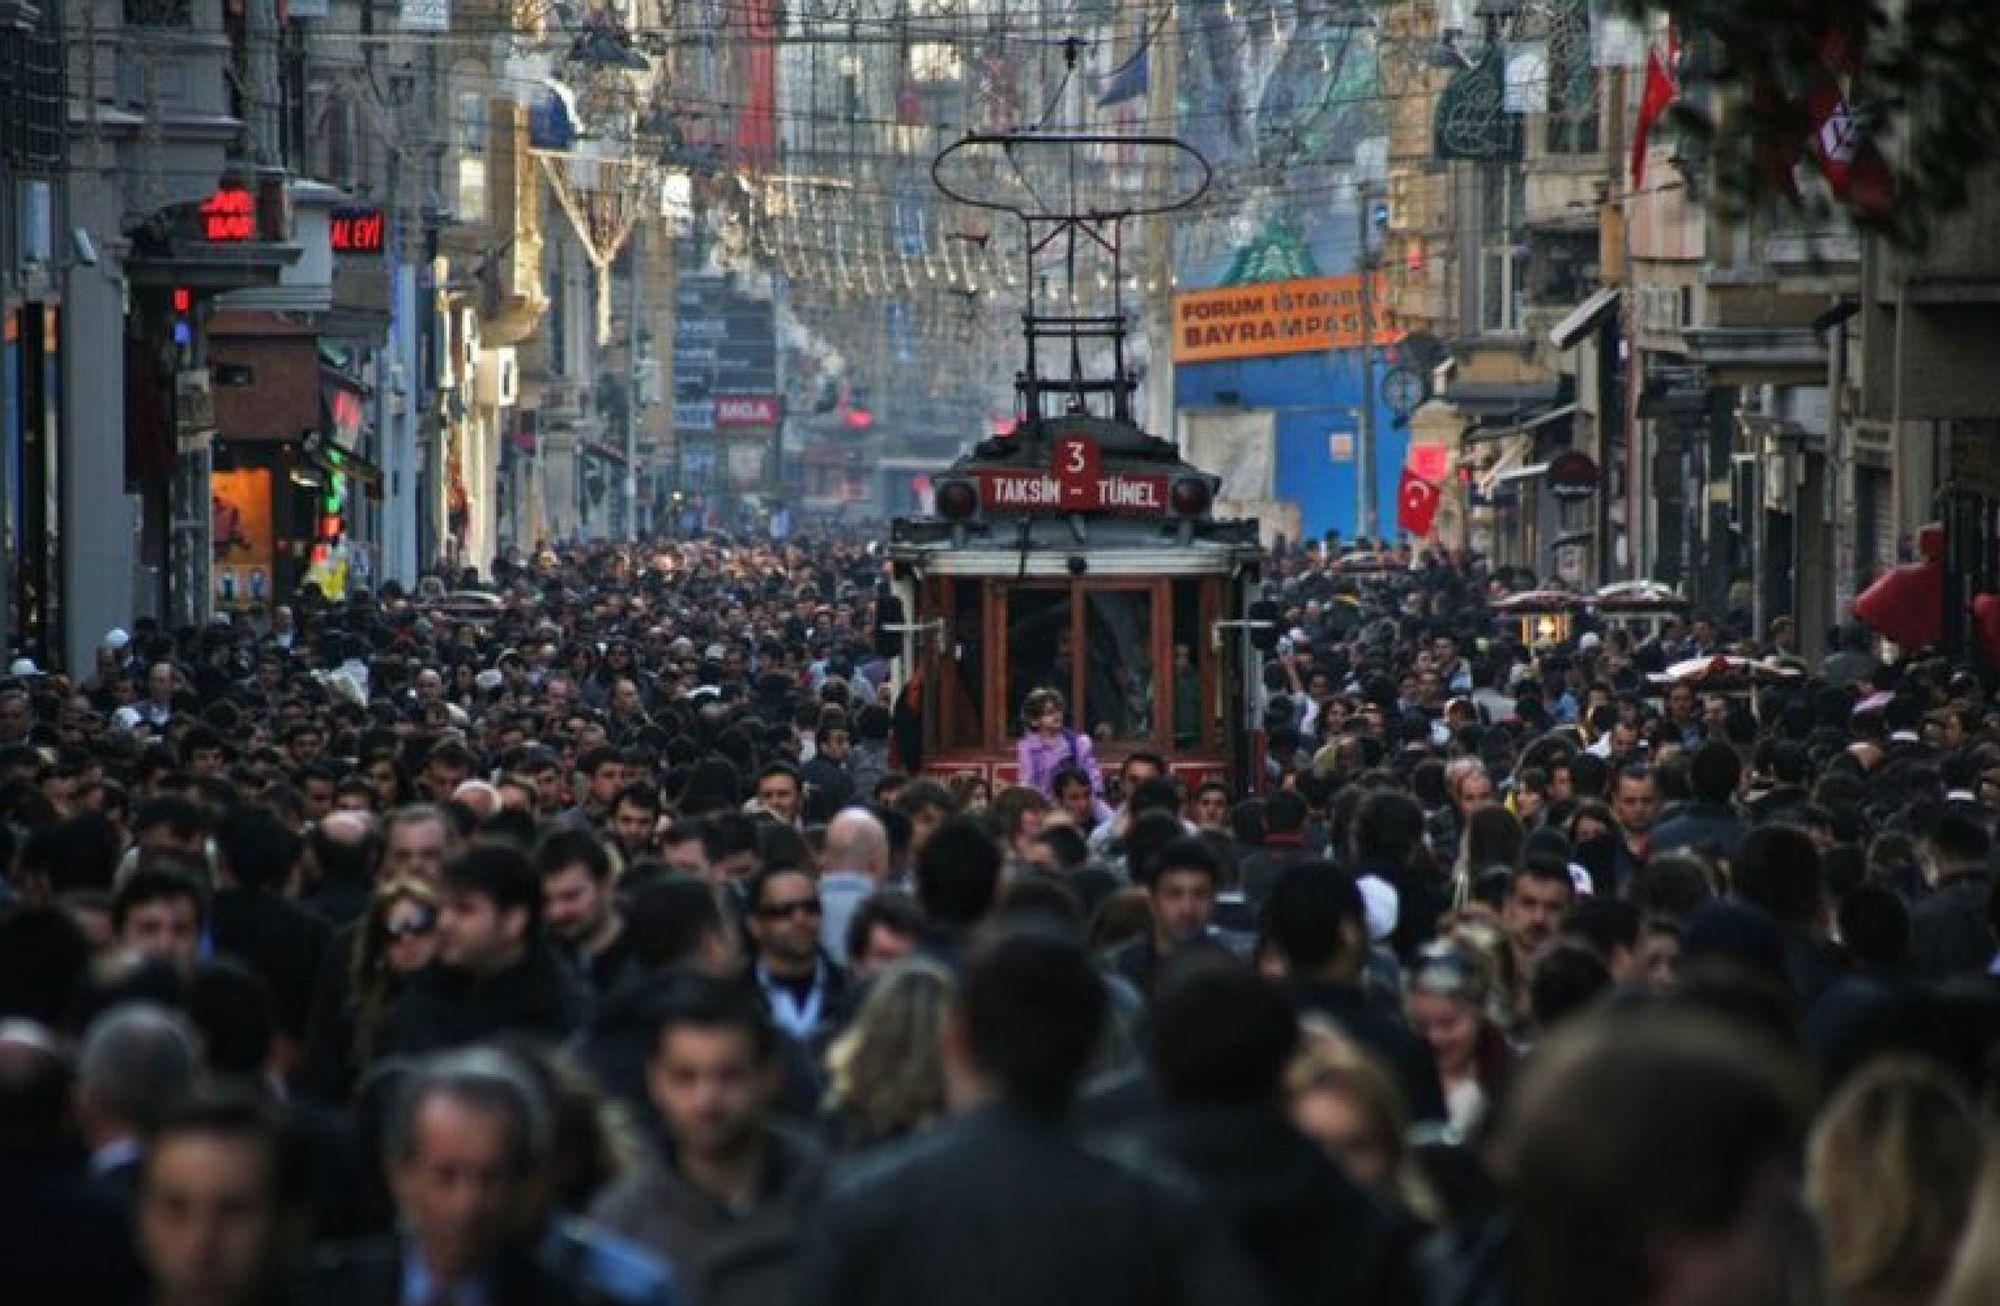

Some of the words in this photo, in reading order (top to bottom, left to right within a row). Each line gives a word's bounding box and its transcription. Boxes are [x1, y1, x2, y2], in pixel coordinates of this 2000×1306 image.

[1182, 294, 1265, 321] FORUM
[1066, 441, 1085, 473] 3
[1097, 475, 1161, 508] TÜNEL
